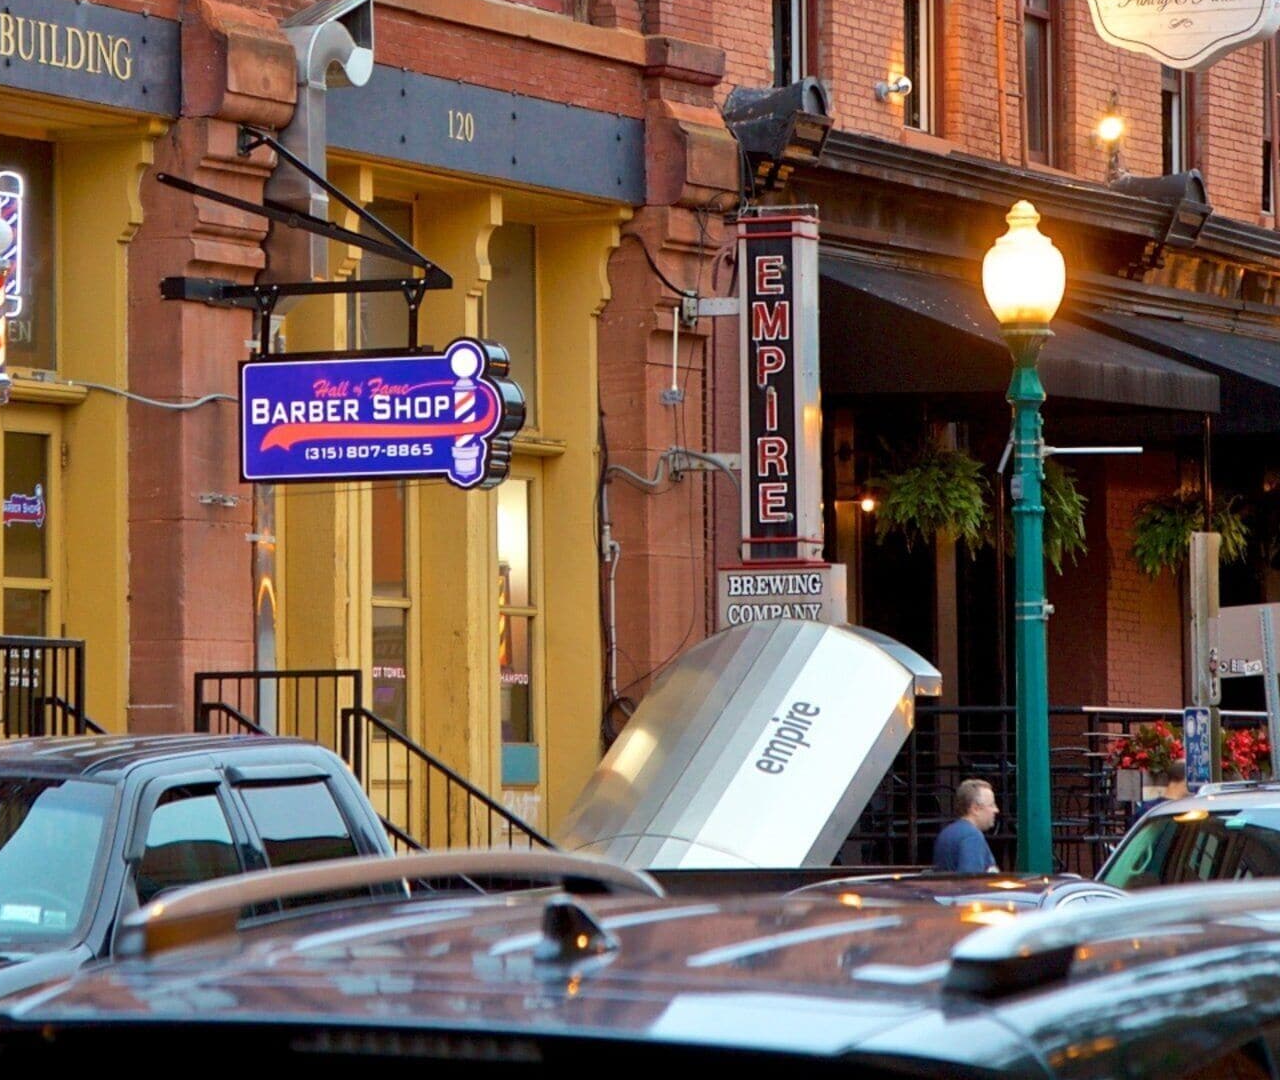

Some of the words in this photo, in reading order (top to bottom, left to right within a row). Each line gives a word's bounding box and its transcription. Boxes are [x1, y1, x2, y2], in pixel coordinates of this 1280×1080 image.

[448, 109, 475, 143] 120
[312, 379, 349, 398] Hall
[353, 381, 364, 397] of
[368, 377, 411, 399] Fame
[751, 255, 793, 524] EMPIRE
[252, 398, 360, 425] BARBER
[372, 394, 450, 420] SHOP
[305, 446, 343, 461] (315)
[346, 444, 434, 459] 807-8865
[728, 573, 823, 596] BREWING
[727, 603, 822, 625] COMPANY
[499, 672, 529, 685] HAMPOO
[755, 701, 821, 775] empire
